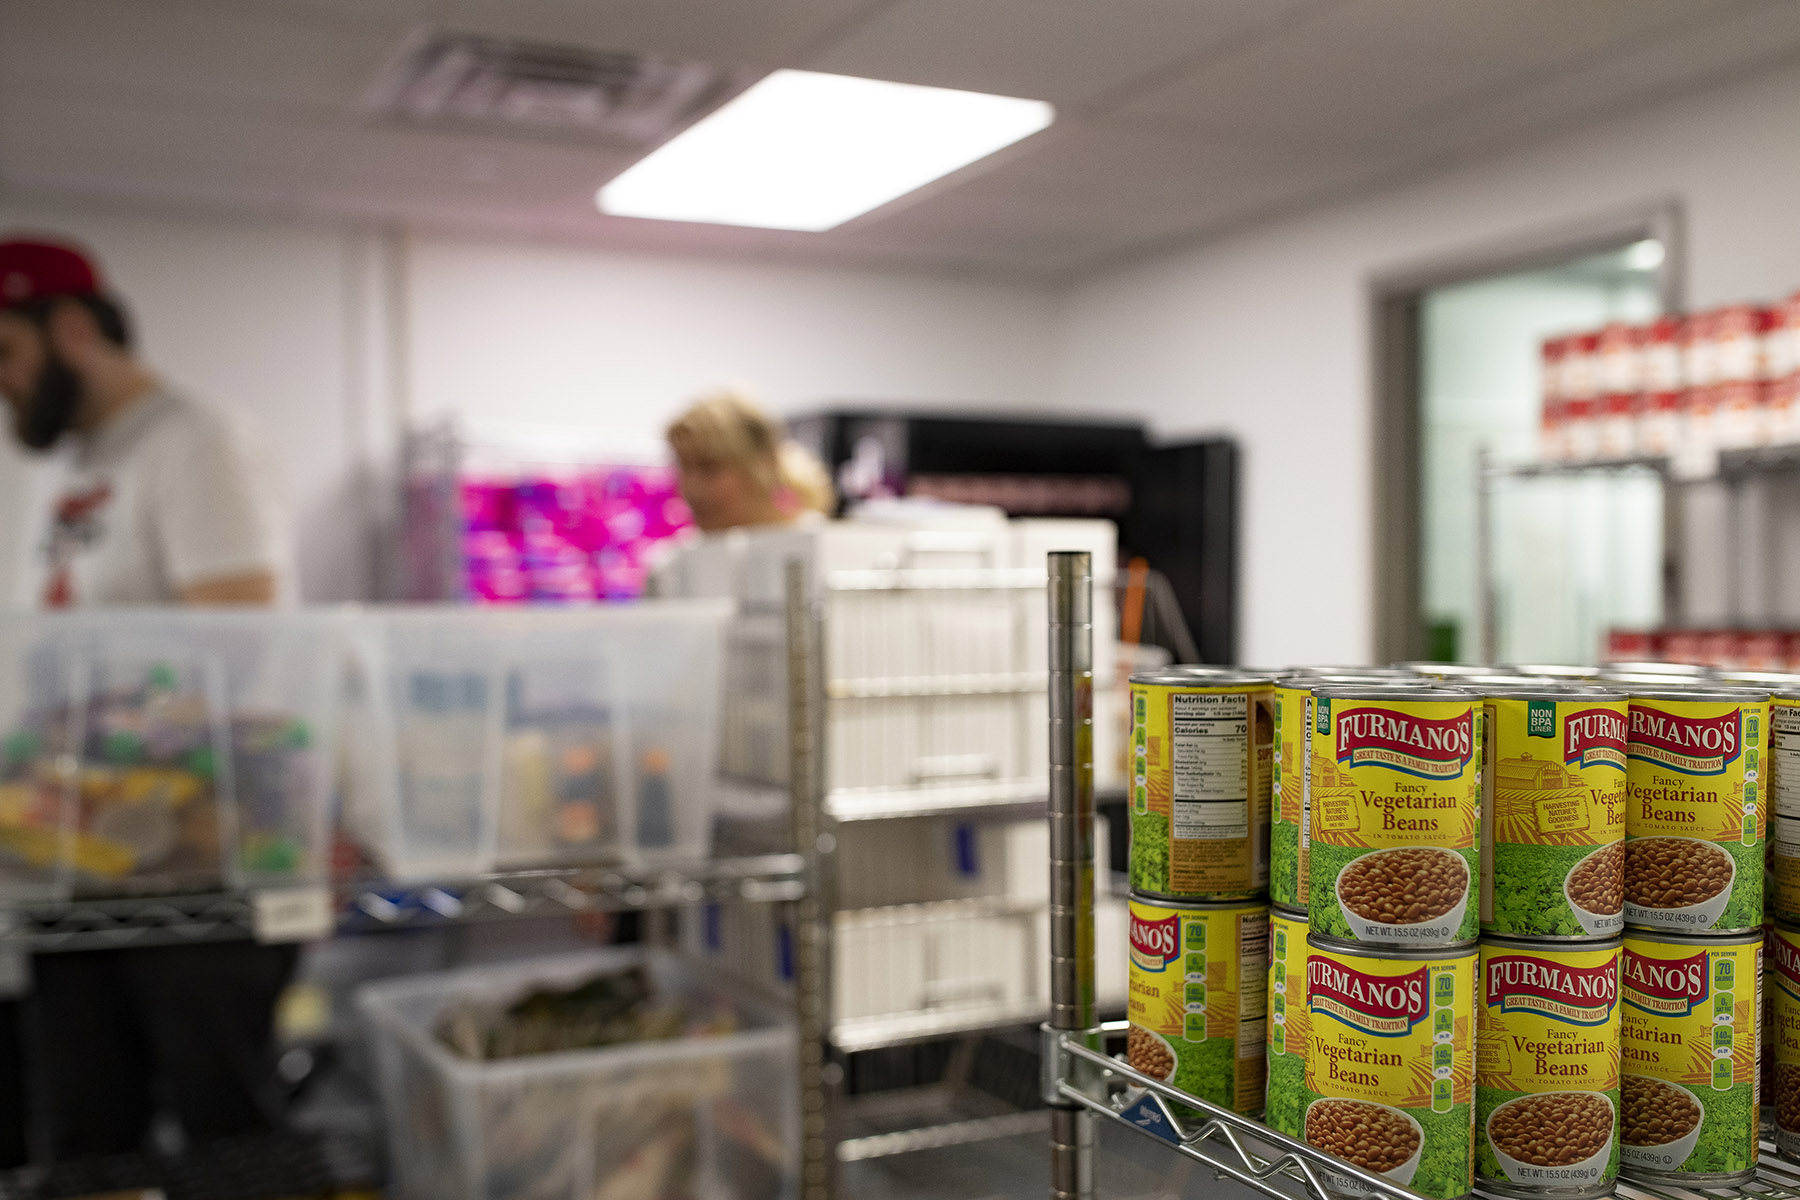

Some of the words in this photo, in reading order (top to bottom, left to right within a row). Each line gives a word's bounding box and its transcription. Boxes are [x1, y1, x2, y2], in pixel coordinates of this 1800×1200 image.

[1174, 696, 1219, 704] Nutrition
[1222, 695, 1247, 704] Facts
[1318, 706, 1329, 715] NON
[1531, 709, 1552, 718] NON
[1317, 714, 1329, 723] BPA
[1531, 717, 1552, 727] BPA
[1748, 720, 1758, 731] 70
[1235, 724, 1247, 733] 70
[1339, 713, 1470, 755] FURMANO'S
[1530, 725, 1552, 733] LINER
[1568, 714, 1628, 754] FURMA
[1629, 710, 1736, 754] RMANO'S
[1354, 750, 1375, 761] GREAT
[1376, 750, 1394, 762] TASTE
[1395, 752, 1402, 763] IS
[1402, 754, 1408, 765] A
[1636, 745, 1653, 757] TASTE
[1653, 748, 1660, 758] IS
[1660, 751, 1665, 760] A
[1664, 753, 1687, 767] FAMILY
[1688, 757, 1722, 770] TRADITION
[1394, 782, 1428, 795] Fancy
[1652, 775, 1685, 789] Fancy
[1590, 788, 1626, 810] Vegeta
[1626, 781, 1718, 804] Vegetarian
[1323, 799, 1349, 808] HARVESTING
[1360, 790, 1457, 814] Vegetarian
[1543, 800, 1580, 811] HARVESTING
[1325, 807, 1347, 815] NATURE'S
[1548, 807, 1577, 817] NATURE'S
[1641, 803, 1696, 823] Beans
[1382, 813, 1439, 831] Beans
[1548, 814, 1579, 824] GOODNESS
[1644, 823, 1676, 831] TOMATO
[1650, 911, 1663, 921] 15.5
[1664, 912, 1675, 922] OZ
[1675, 913, 1697, 924] (439g)
[1131, 915, 1175, 955] ANO'S
[1189, 926, 1202, 937] 70
[1394, 928, 1409, 937] 15.5
[1409, 928, 1419, 937] OZ
[1718, 962, 1731, 975] 70
[1307, 961, 1422, 1014] FURMANO'S
[1439, 977, 1451, 990] 70
[1489, 961, 1615, 1000] FURMANO'S
[1505, 997, 1525, 1007] GREAT
[1528, 998, 1547, 1010] TASTE
[1547, 1001, 1554, 1011] IS
[1554, 1003, 1559, 1012] A
[1559, 1004, 1581, 1019] FAMILY
[1581, 1008, 1607, 1020] TRADITION
[1630, 992, 1651, 1006] FAMILY
[1652, 1000, 1687, 1011] TRADITION
[1348, 1009, 1371, 1026] FAMILY
[1372, 1017, 1407, 1031] TRADITION
[1621, 1012, 1648, 1028] Fancy
[1338, 1033, 1368, 1050] Fancy
[1547, 1028, 1578, 1041] Fancy
[1621, 1025, 1682, 1045] etarian
[1780, 1034, 1800, 1050] Bea
[1315, 1036, 1403, 1067] Vegetarian
[1512, 1035, 1605, 1059] Vegetarian
[1622, 1046, 1660, 1063] eans
[1328, 1062, 1379, 1087] Beans
[1534, 1058, 1588, 1076] Beans
[1645, 1065, 1669, 1073] SAUCE
[1331, 1082, 1360, 1093] TOMATO
[1363, 1089, 1389, 1097] SAUCE
[1622, 1148, 1631, 1158] 5.5
[1632, 1150, 1640, 1160] OZ
[1641, 1152, 1661, 1165] (439g)
[1546, 1170, 1560, 1179] 15.5
[1560, 1170, 1570, 1179] OZ
[1571, 1169, 1589, 1180] (439g)
[1349, 1181, 1358, 1191] OZ
